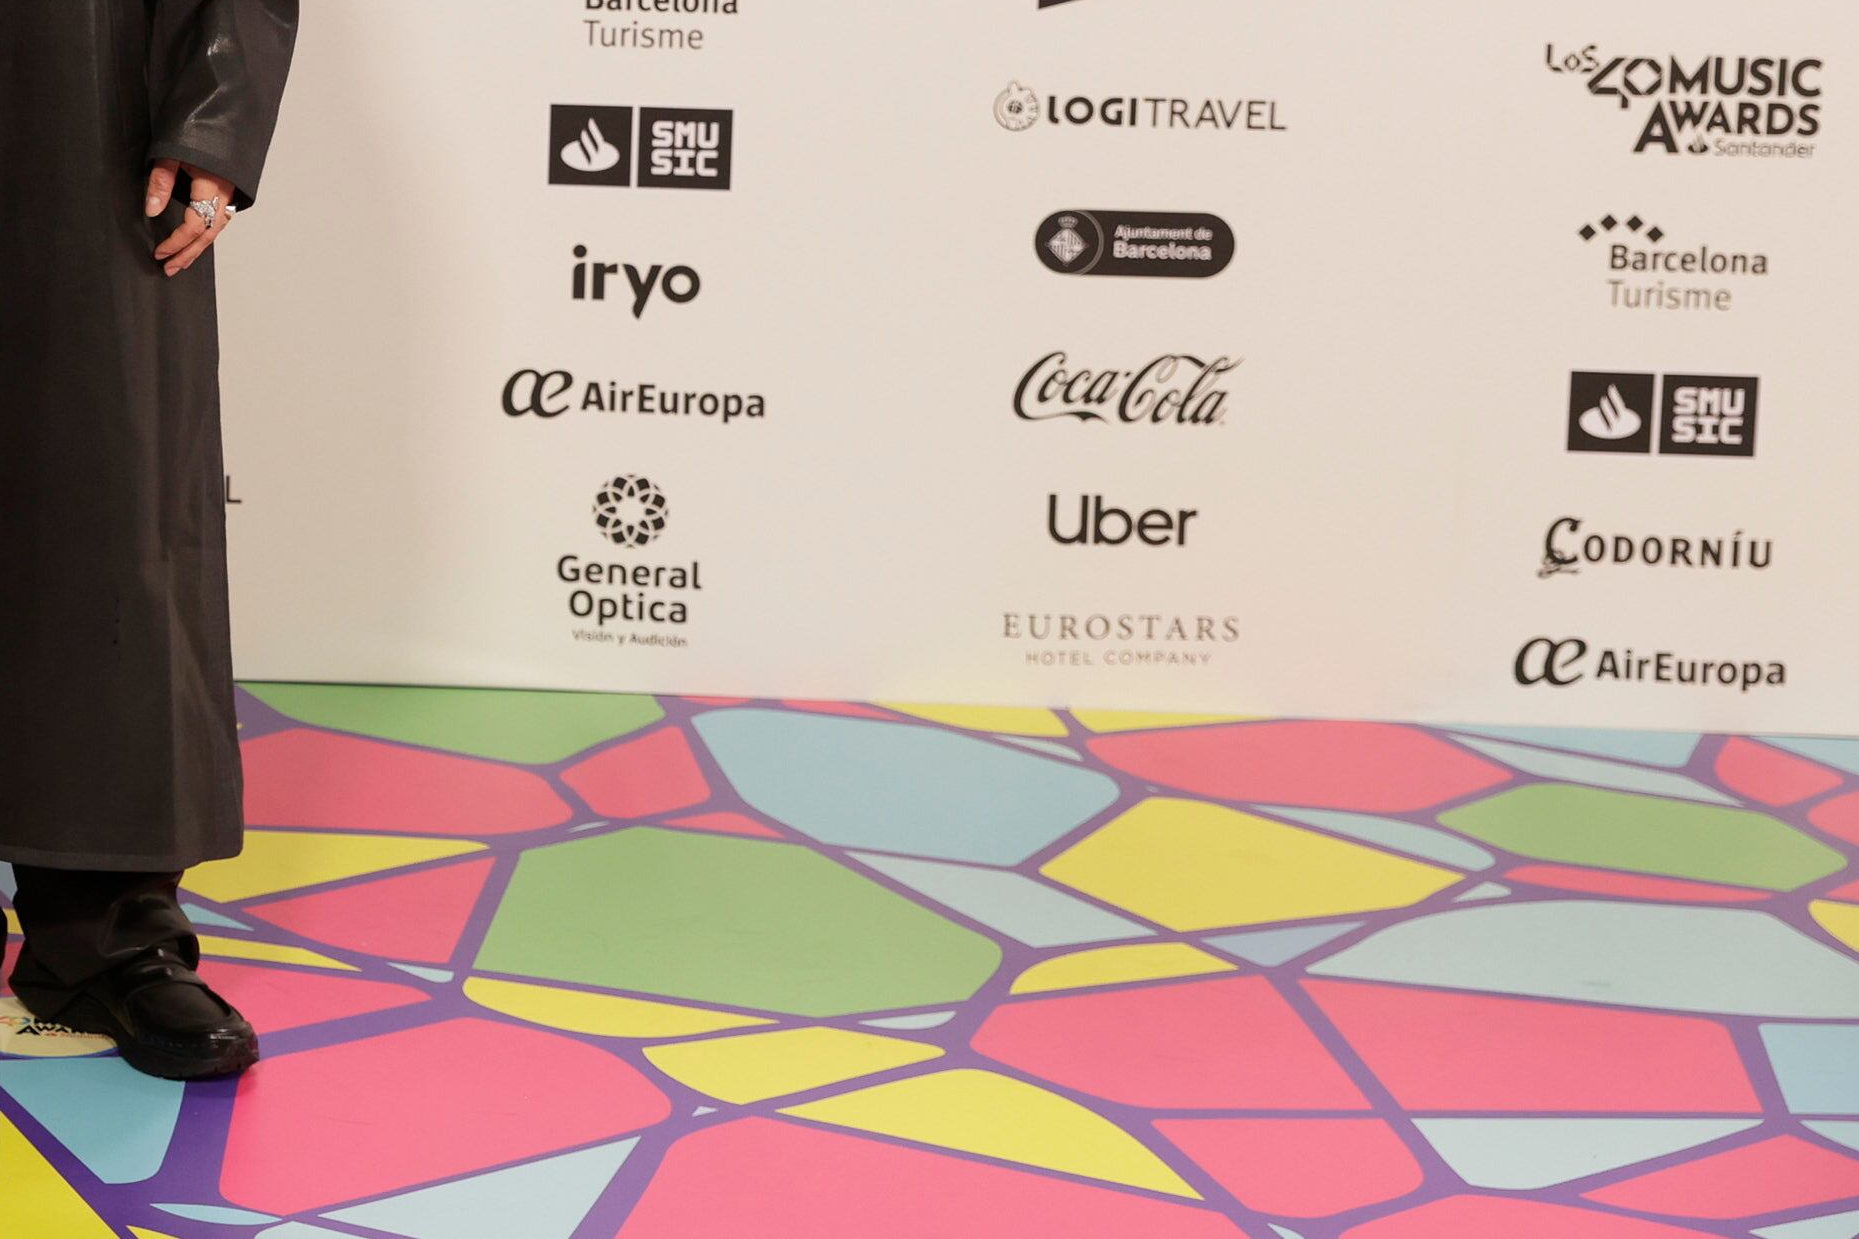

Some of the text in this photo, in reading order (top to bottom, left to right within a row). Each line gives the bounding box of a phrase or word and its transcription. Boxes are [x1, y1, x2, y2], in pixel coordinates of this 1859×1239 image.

[584, 19, 704, 50] Turisme
[1587, 57, 1663, 109] 40
[1669, 54, 1823, 97] MUSIC
[1047, 95, 1288, 131] LOGITRAVEL
[1633, 100, 1821, 153] AWARDS
[1714, 138, 1815, 157] Santander
[1114, 224, 1213, 242] Ajuntament de
[1113, 241, 1212, 261] Barcelona
[1610, 244, 1768, 275] Barcelona
[572, 244, 701, 320] iryo
[1608, 279, 1732, 311] Turisme
[1013, 351, 1245, 426] Coca-Cola
[1048, 493, 1198, 546] Uber
[557, 555, 702, 590] General
[569, 590, 688, 625] Optica
[1002, 613, 1240, 642] EUROSTARS
[1025, 650, 1212, 666] HOTEL COMPANY
